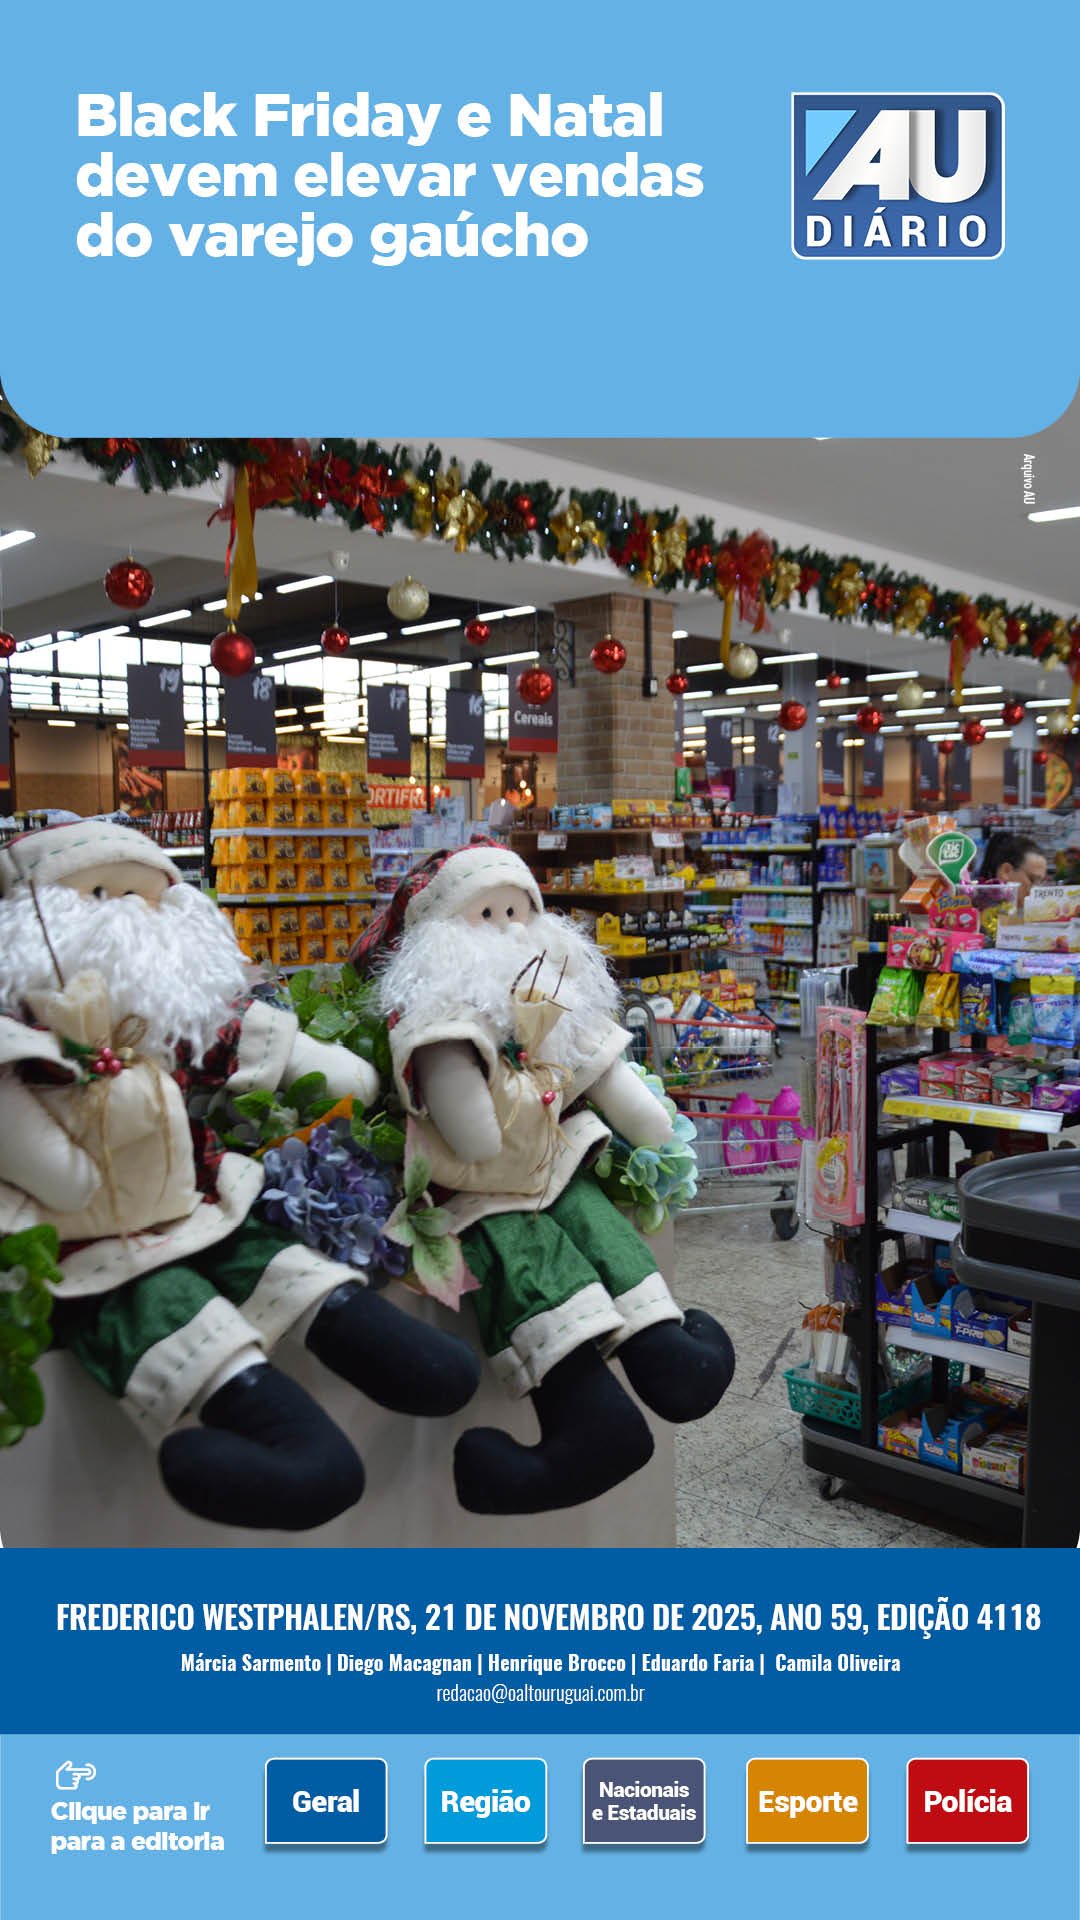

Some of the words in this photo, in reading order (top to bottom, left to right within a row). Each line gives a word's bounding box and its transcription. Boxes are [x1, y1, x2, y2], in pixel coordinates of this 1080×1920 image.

[159, 667, 181, 694] 19
[252, 675, 273, 702] 18
[467, 694, 484, 717] 16
[513, 710, 554, 728] Cereais
